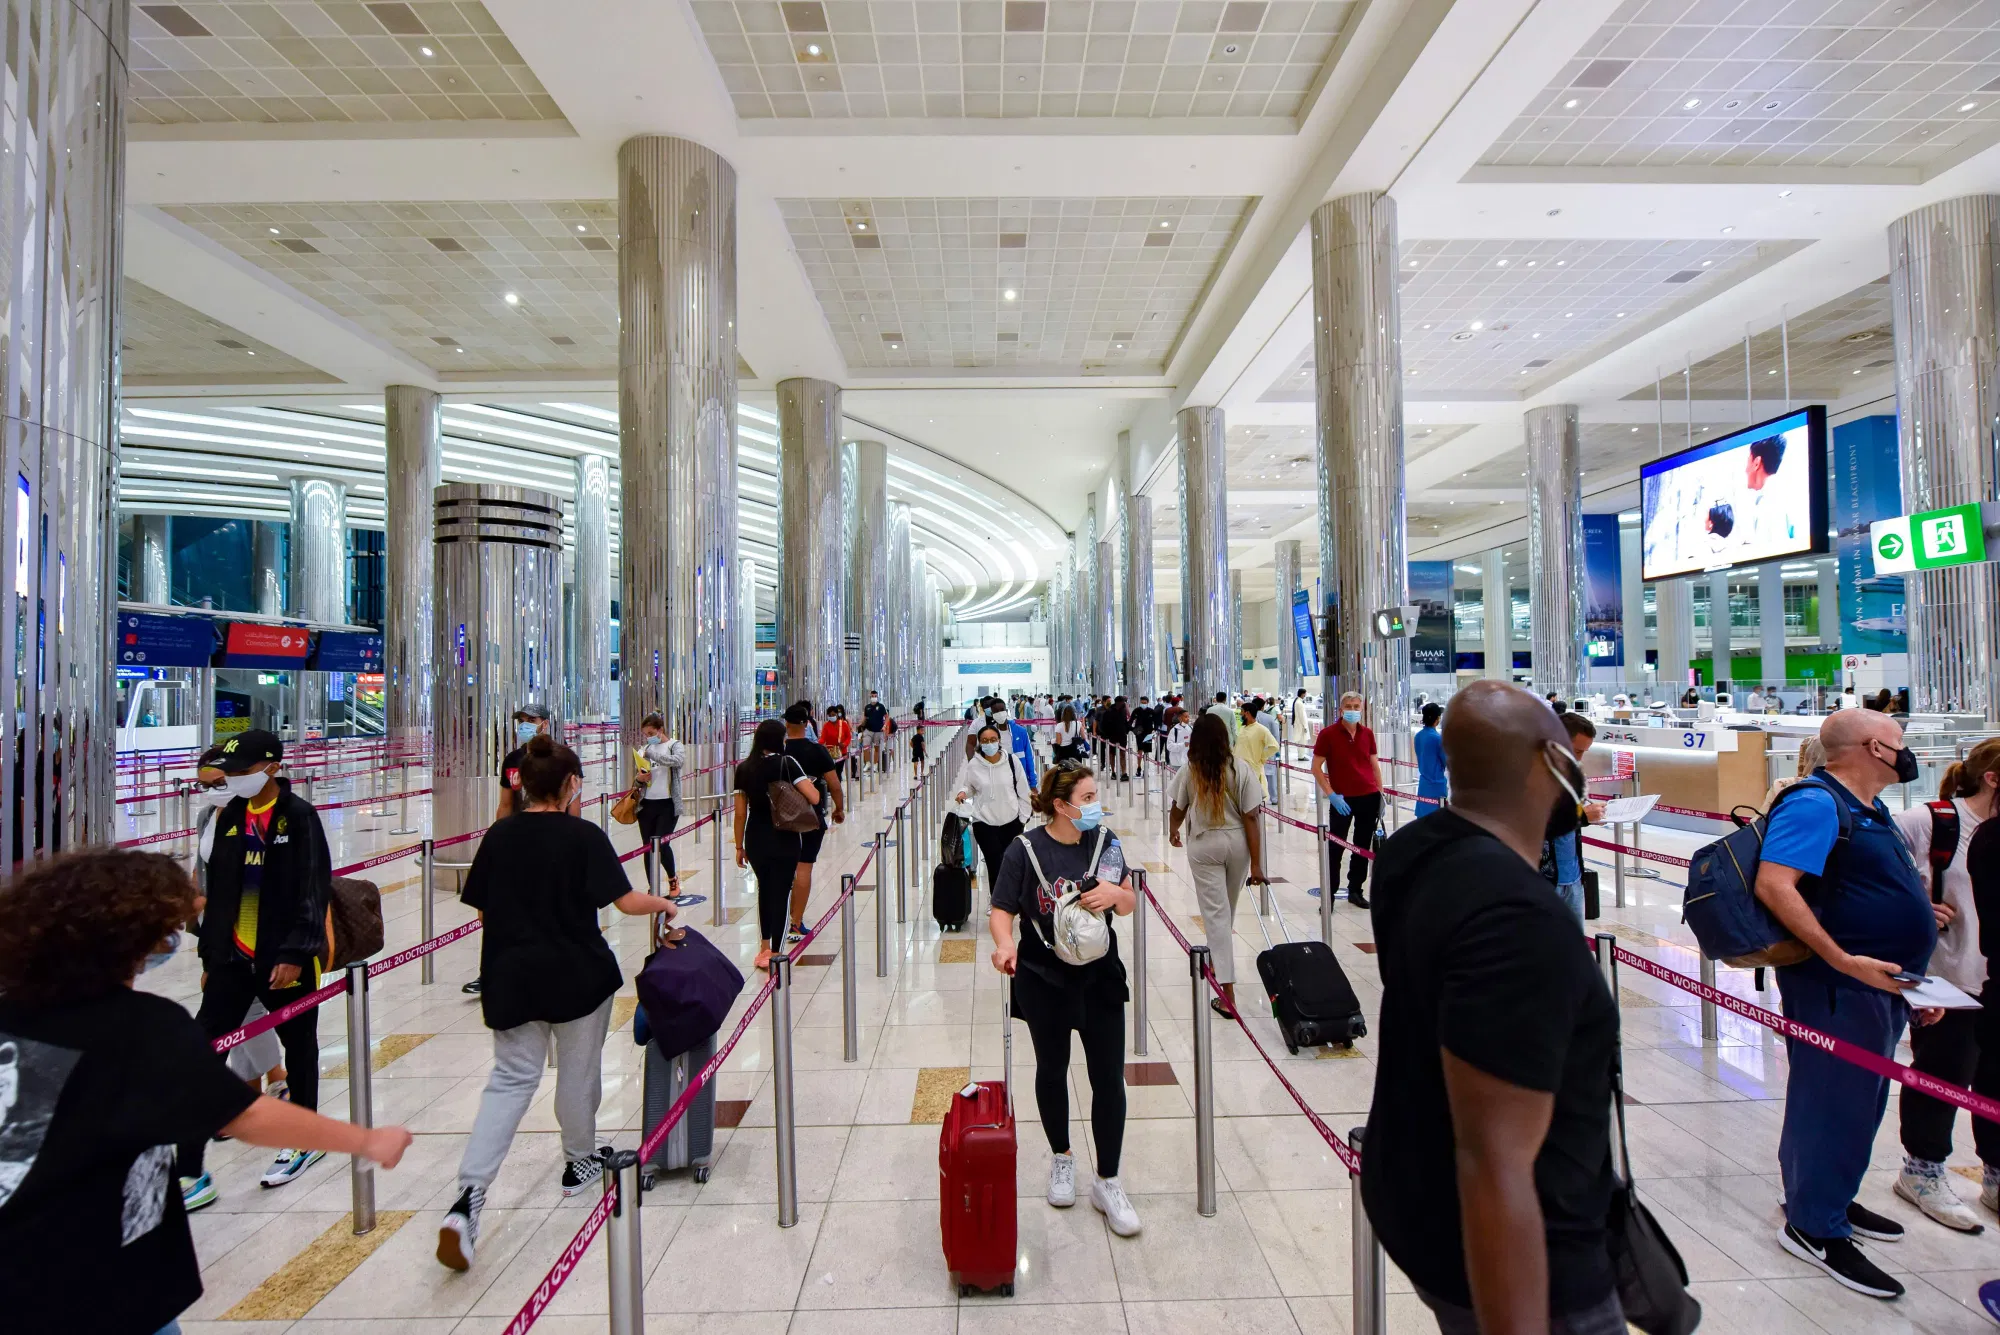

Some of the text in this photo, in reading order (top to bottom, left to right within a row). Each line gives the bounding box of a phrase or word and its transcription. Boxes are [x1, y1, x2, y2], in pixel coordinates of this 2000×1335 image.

[1848, 444, 1859, 509] BEACHFRONT
[1851, 511, 1861, 545] EMAAR
[1853, 549, 1861, 561] IN
[1854, 564, 1863, 593] HOME
[1855, 607, 1864, 632] OWN
[246, 639, 280, 648] Connections
[1415, 650, 1445, 658] EMAAR
[1683, 732, 1706, 748] 37
[138, 837, 155, 845] EXPO
[155, 833, 170, 841] 2020
[363, 859, 377, 868] VISIT
[1626, 847, 1692, 867] VISIT EXPO2020DUBA
[394, 954, 405, 965] 20
[405, 940, 438, 960] OCTOBER
[438, 933, 454, 946] 2020
[459, 926, 468, 936] 10
[1617, 949, 1648, 971] DUBAI:
[1650, 964, 1670, 981] THE
[1671, 972, 1722, 1004] WORLD'S
[1724, 995, 1788, 1031] GREATEST
[1789, 1023, 1836, 1052] SHOW
[215, 1028, 247, 1053] 2021
[701, 1061, 716, 1087] EXPO
[1919, 1077, 1945, 1094] EXPO
[1944, 1088, 1969, 1104] 2020
[1333, 1136, 1362, 1173] GREA
[532, 1283, 550, 1317] 20
[551, 1204, 607, 1287] OCTOBER
